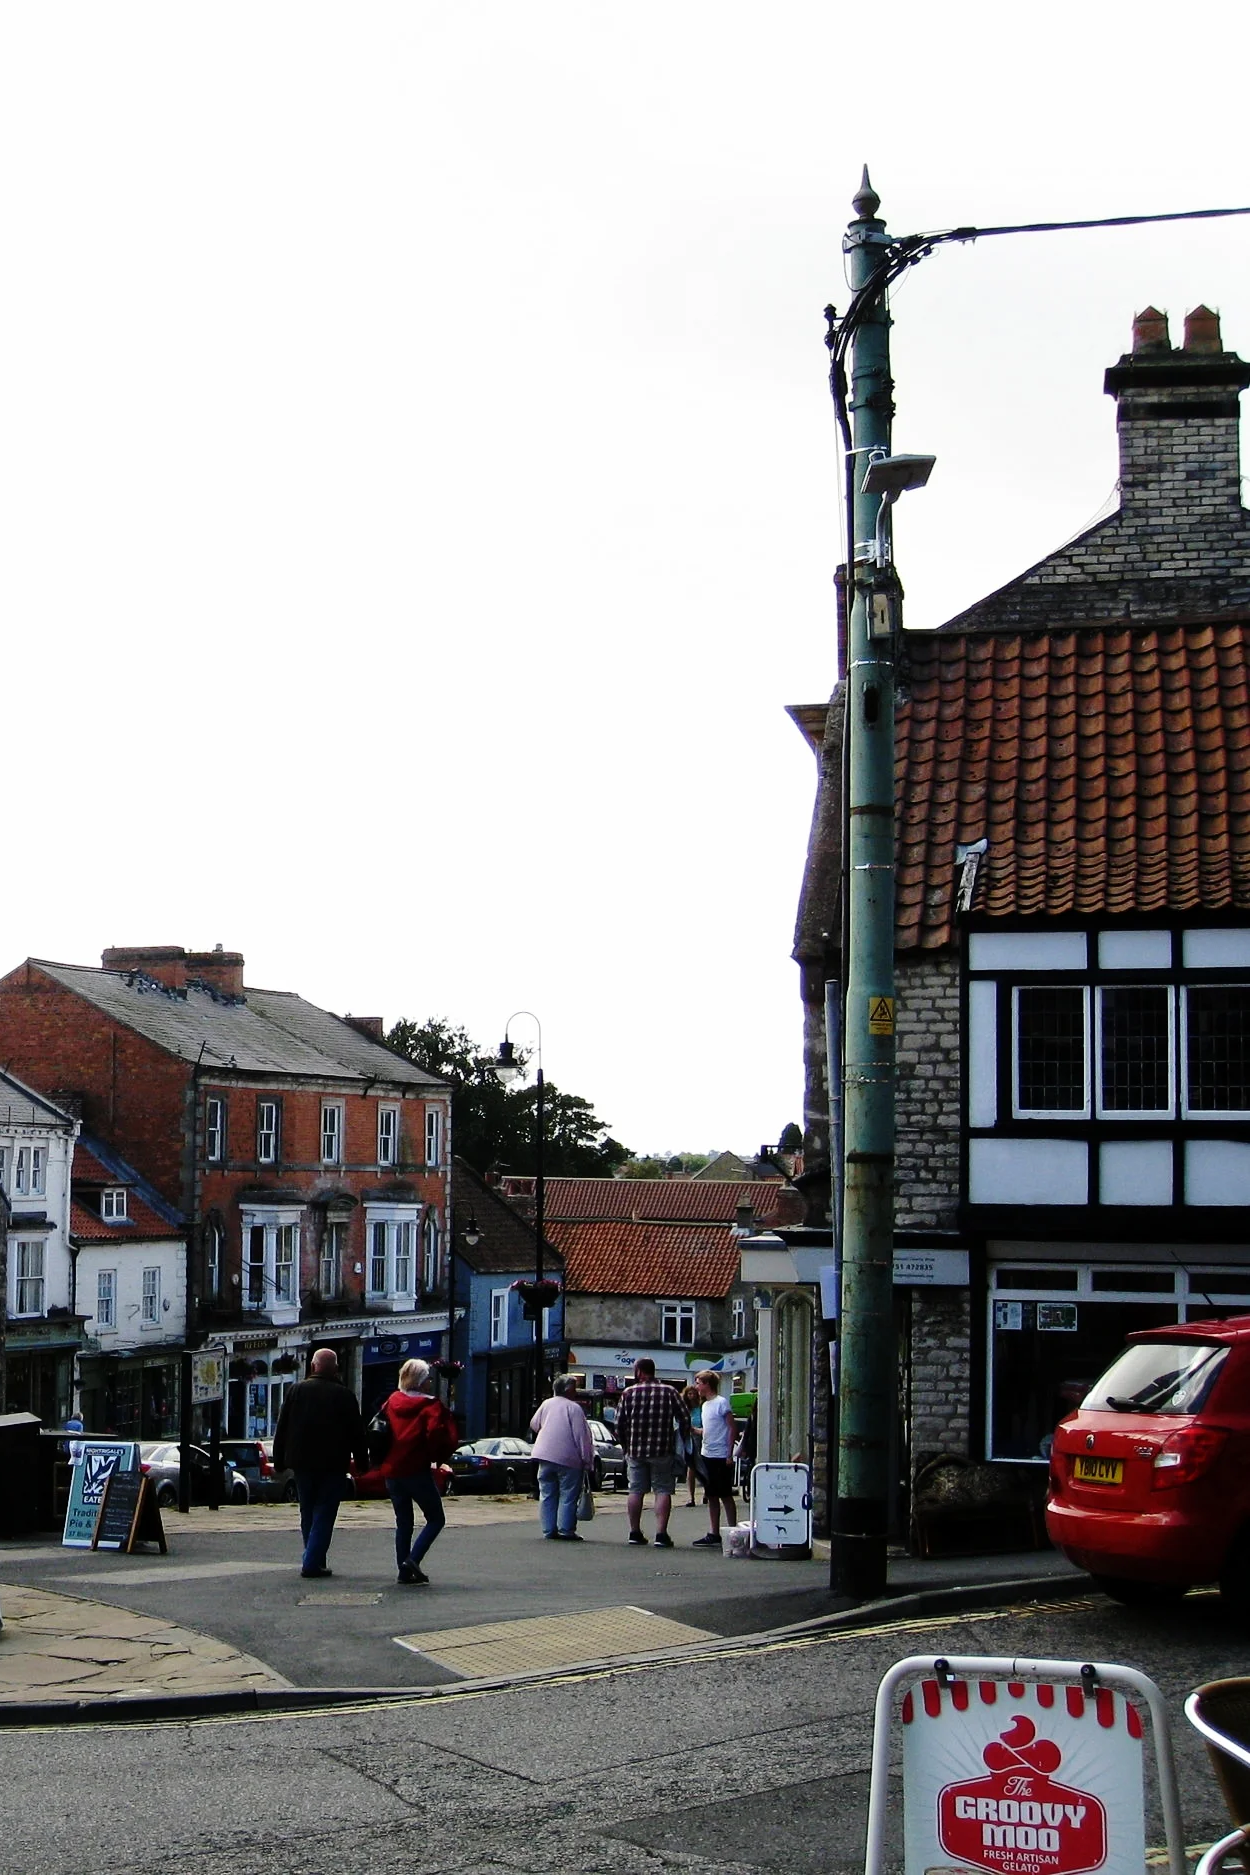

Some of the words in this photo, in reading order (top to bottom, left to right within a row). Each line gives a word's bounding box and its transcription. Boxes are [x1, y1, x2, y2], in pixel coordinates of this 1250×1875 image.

[83, 1496, 101, 1504] EATE
[73, 1508, 97, 1518] Tradit
[1003, 1776, 1035, 1797] The
[955, 1796, 1086, 1829] GROOVY
[982, 1823, 1060, 1852] MOO
[983, 1850, 1014, 1861] FRESH
[1015, 1854, 1059, 1865] ARTISAN
[1002, 1861, 1040, 1874] GELATO
